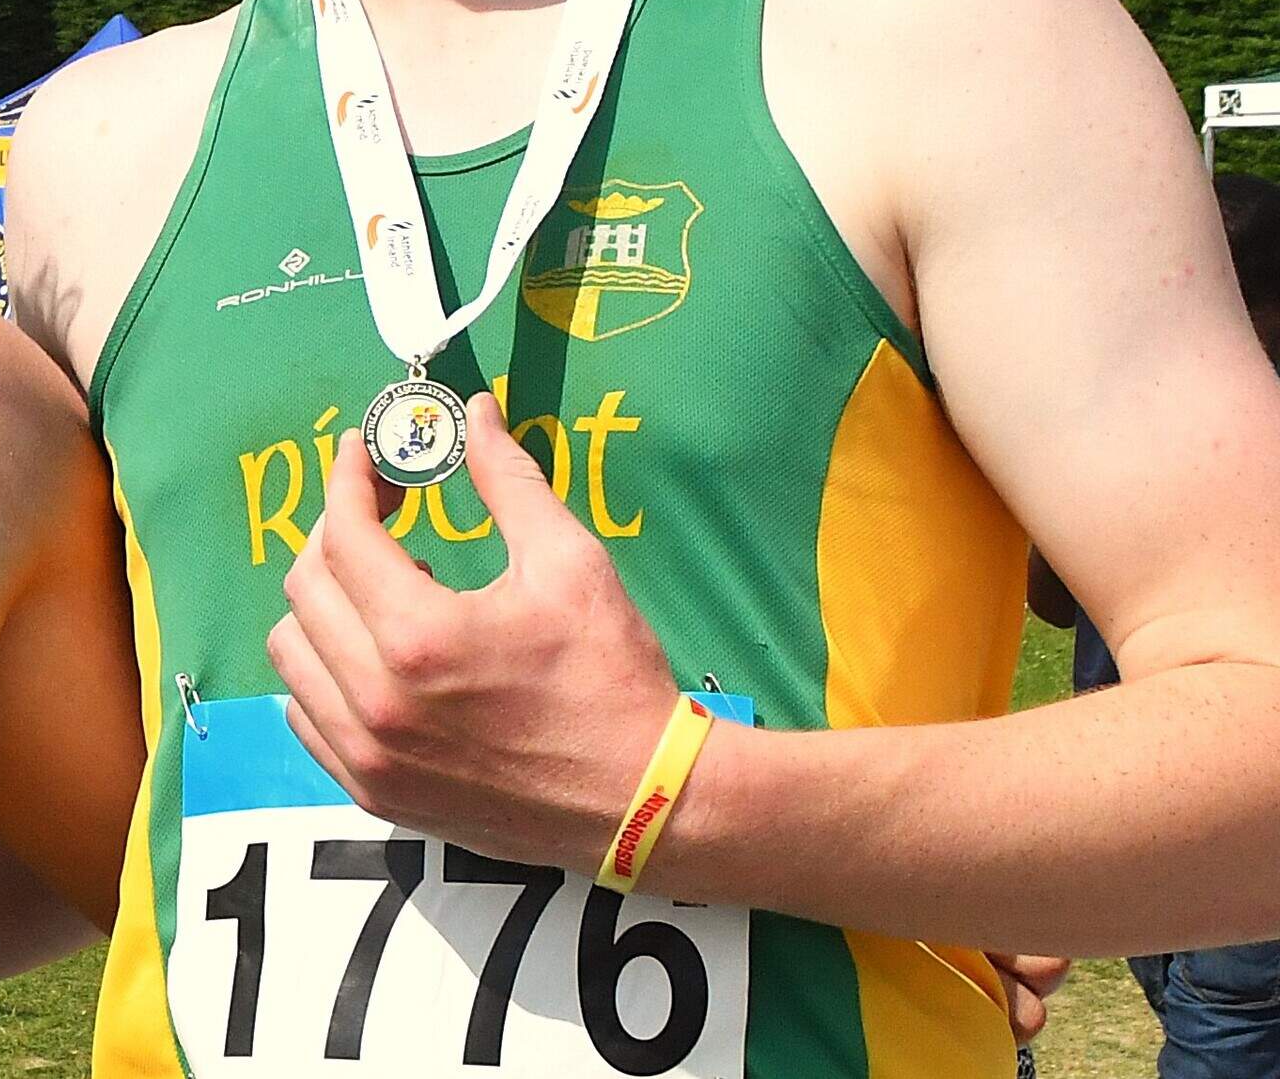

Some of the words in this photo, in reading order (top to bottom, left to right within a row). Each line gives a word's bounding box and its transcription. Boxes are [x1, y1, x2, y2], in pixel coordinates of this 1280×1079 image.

[215, 269, 364, 312] RONHILL
[613, 792, 670, 879] WISCONSIN
[204, 839, 709, 1077] 1776
